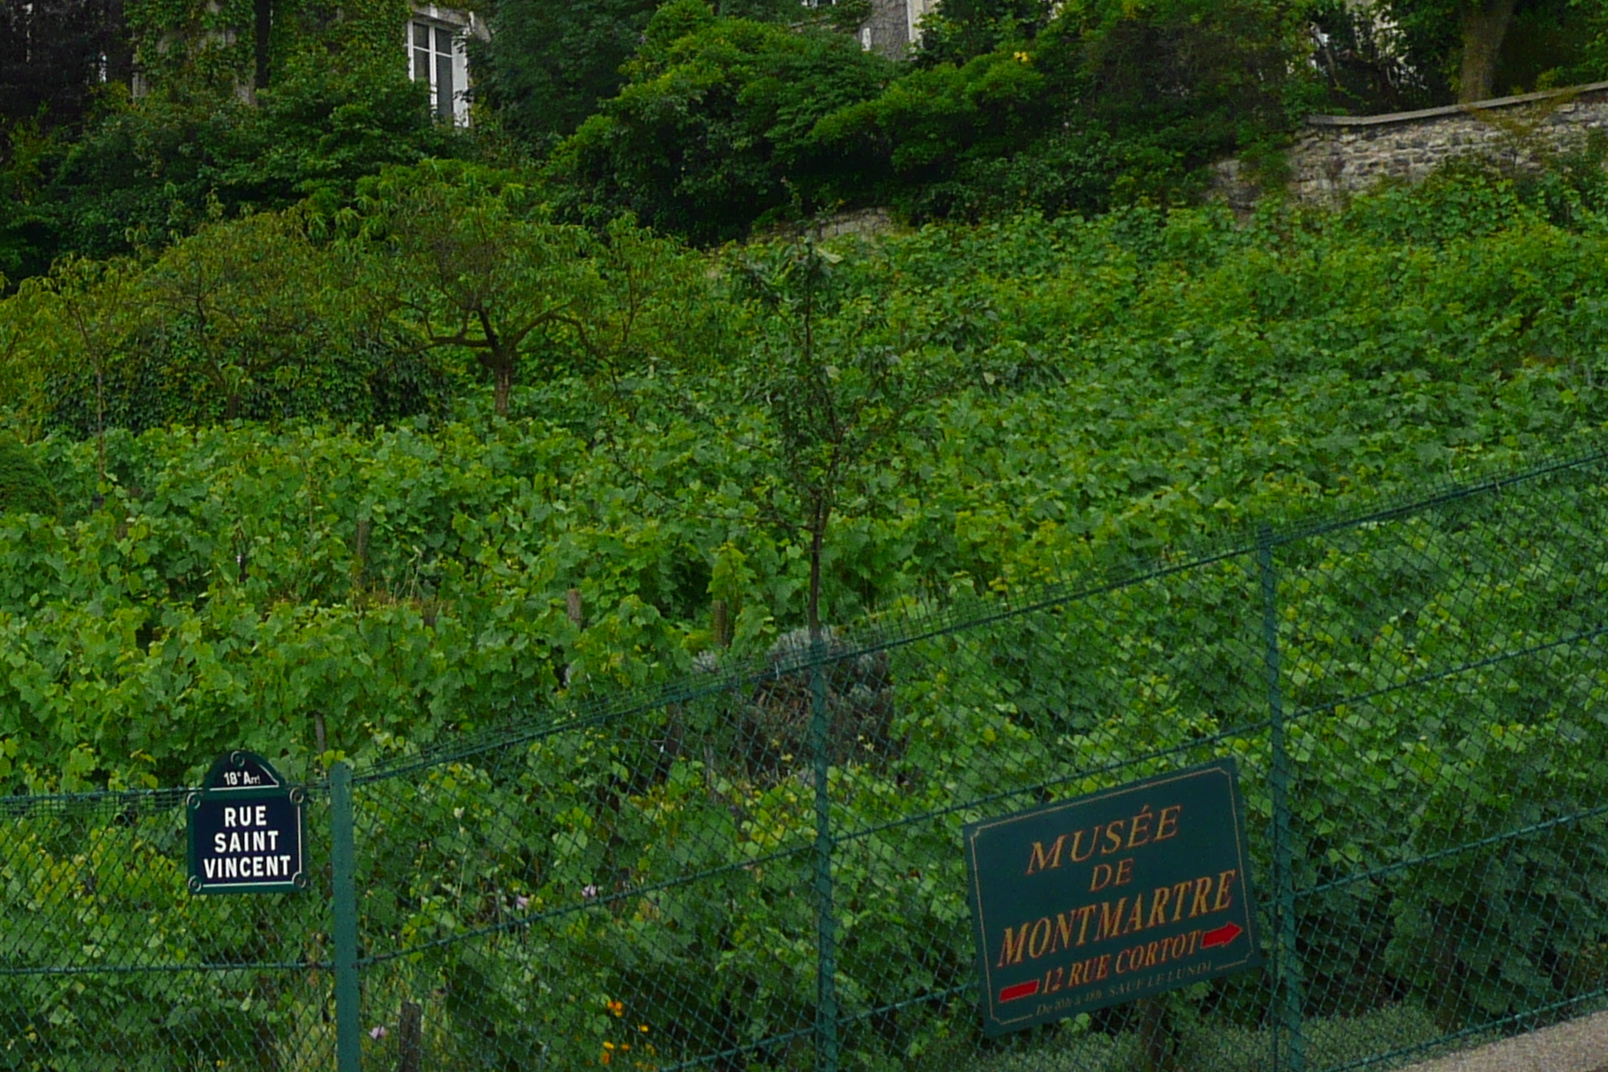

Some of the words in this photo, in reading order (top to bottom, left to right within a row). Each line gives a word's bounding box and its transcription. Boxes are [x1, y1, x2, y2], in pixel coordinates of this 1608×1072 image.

[224, 805, 267, 827] RUE
[214, 830, 279, 853] SAINT
[1025, 804, 1182, 876] MUSÉE
[203, 855, 291, 878] VINCENT
[1088, 858, 1134, 892] DE
[996, 869, 1238, 968] MONTMARTRE
[1042, 967, 1064, 995] 12
[1067, 954, 1112, 988] RUE
[1115, 929, 1203, 974] CORTOT
